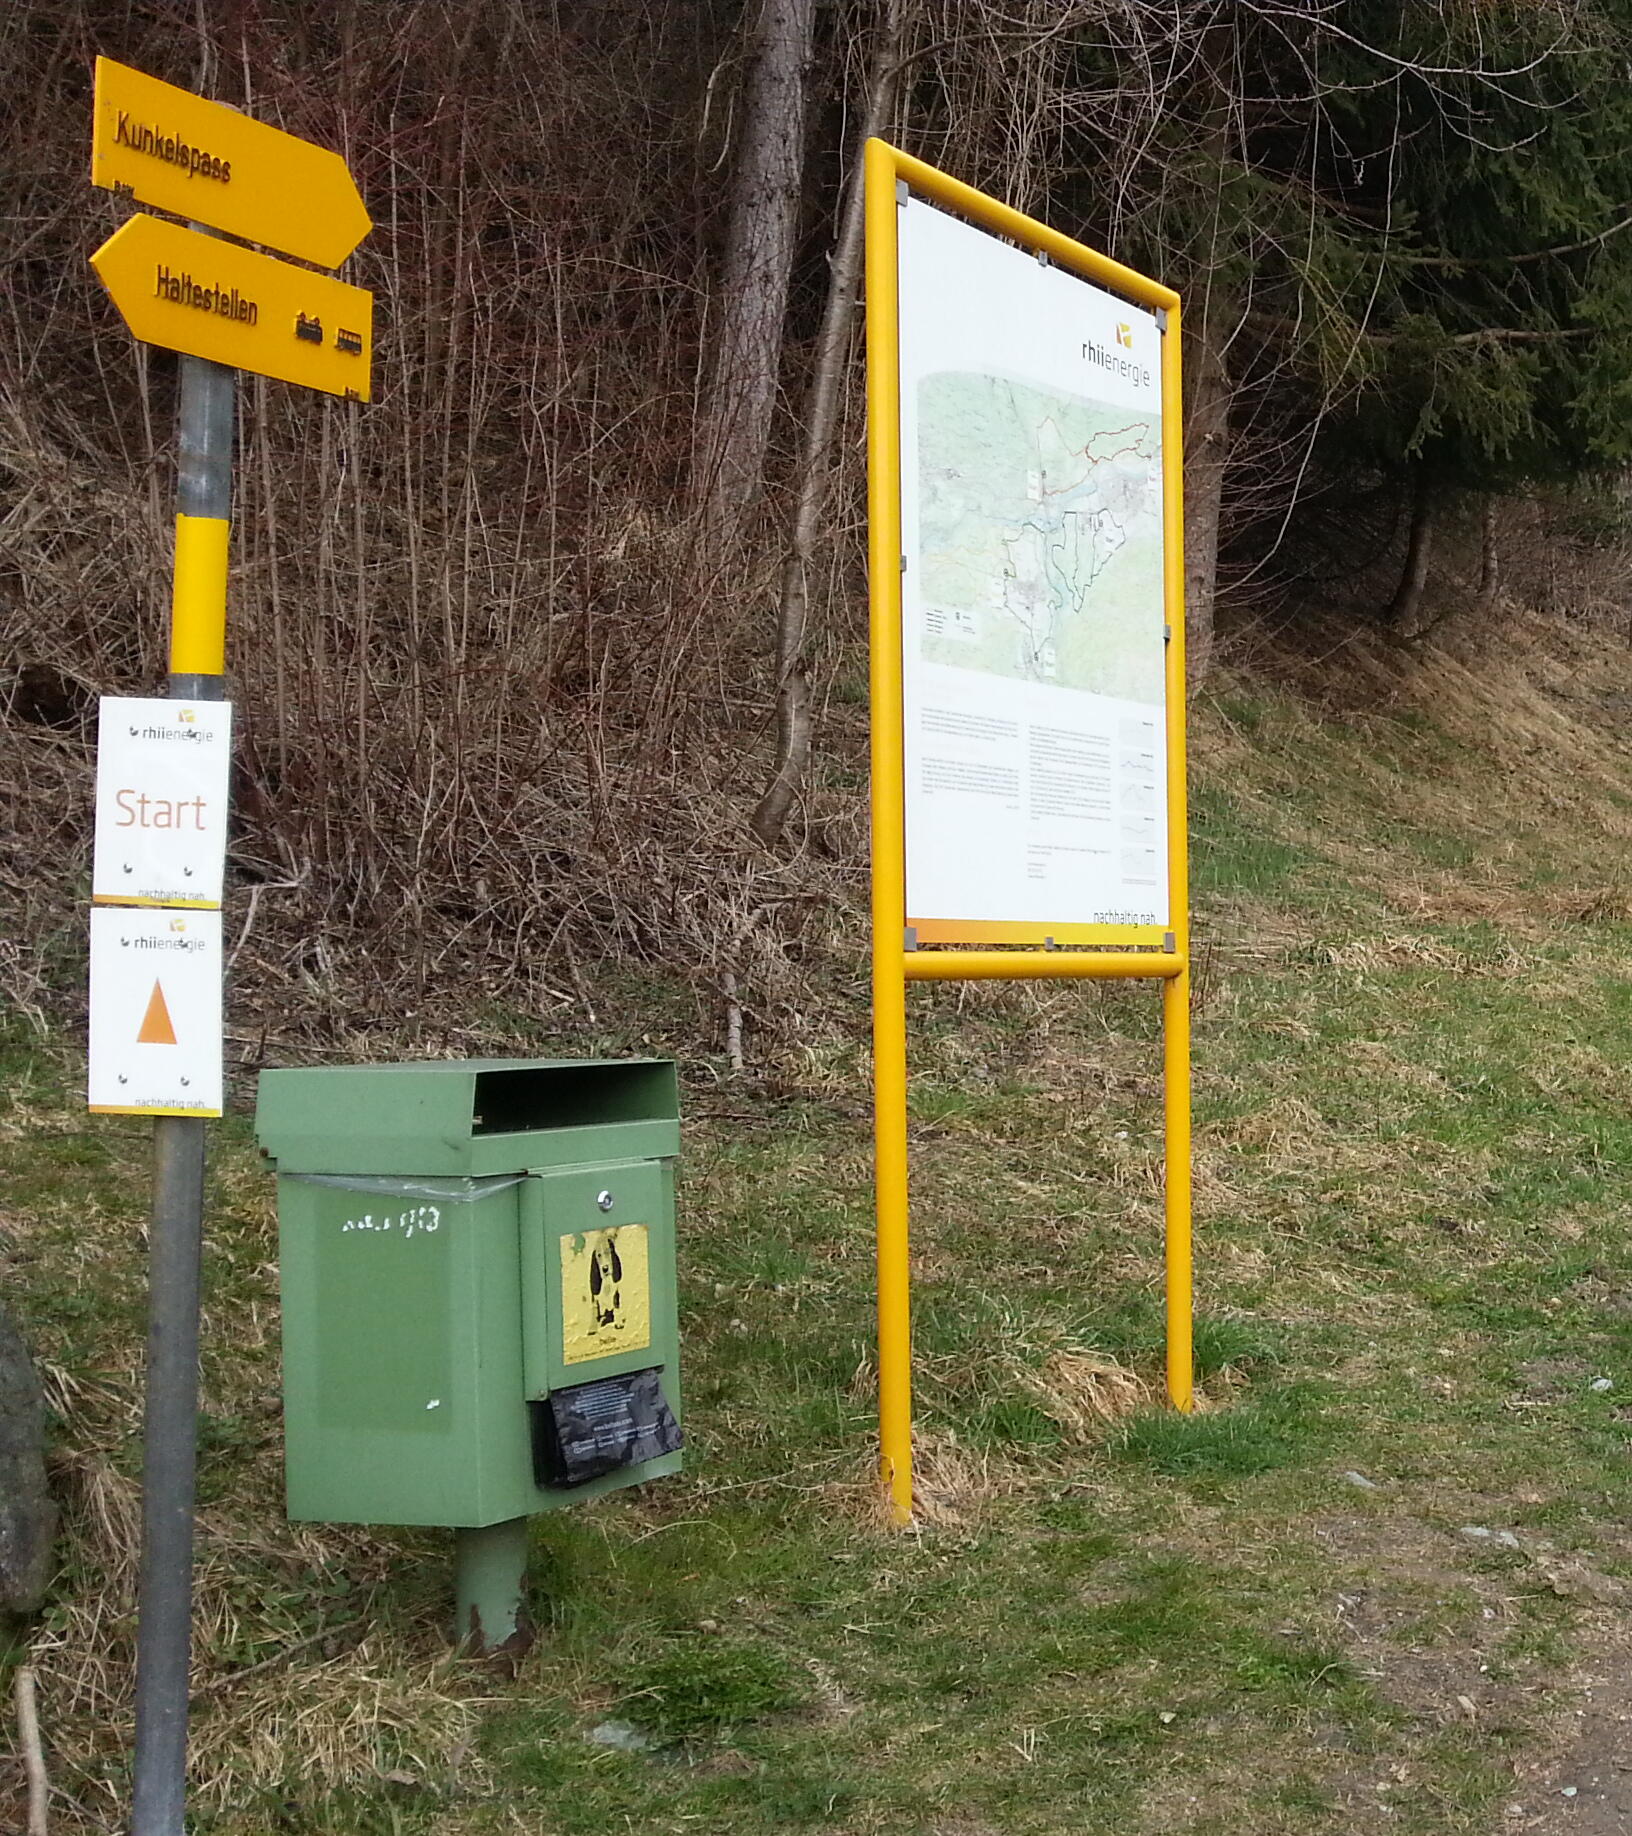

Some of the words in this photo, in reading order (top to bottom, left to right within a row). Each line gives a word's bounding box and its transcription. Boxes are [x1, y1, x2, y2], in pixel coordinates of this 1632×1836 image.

[114, 108, 232, 184] Kunkelspass
[154, 263, 259, 327] Haltestellen
[1082, 339, 1151, 387] rhiienergie
[115, 788, 207, 831] Start
[1093, 909, 1138, 928] nachhaltig
